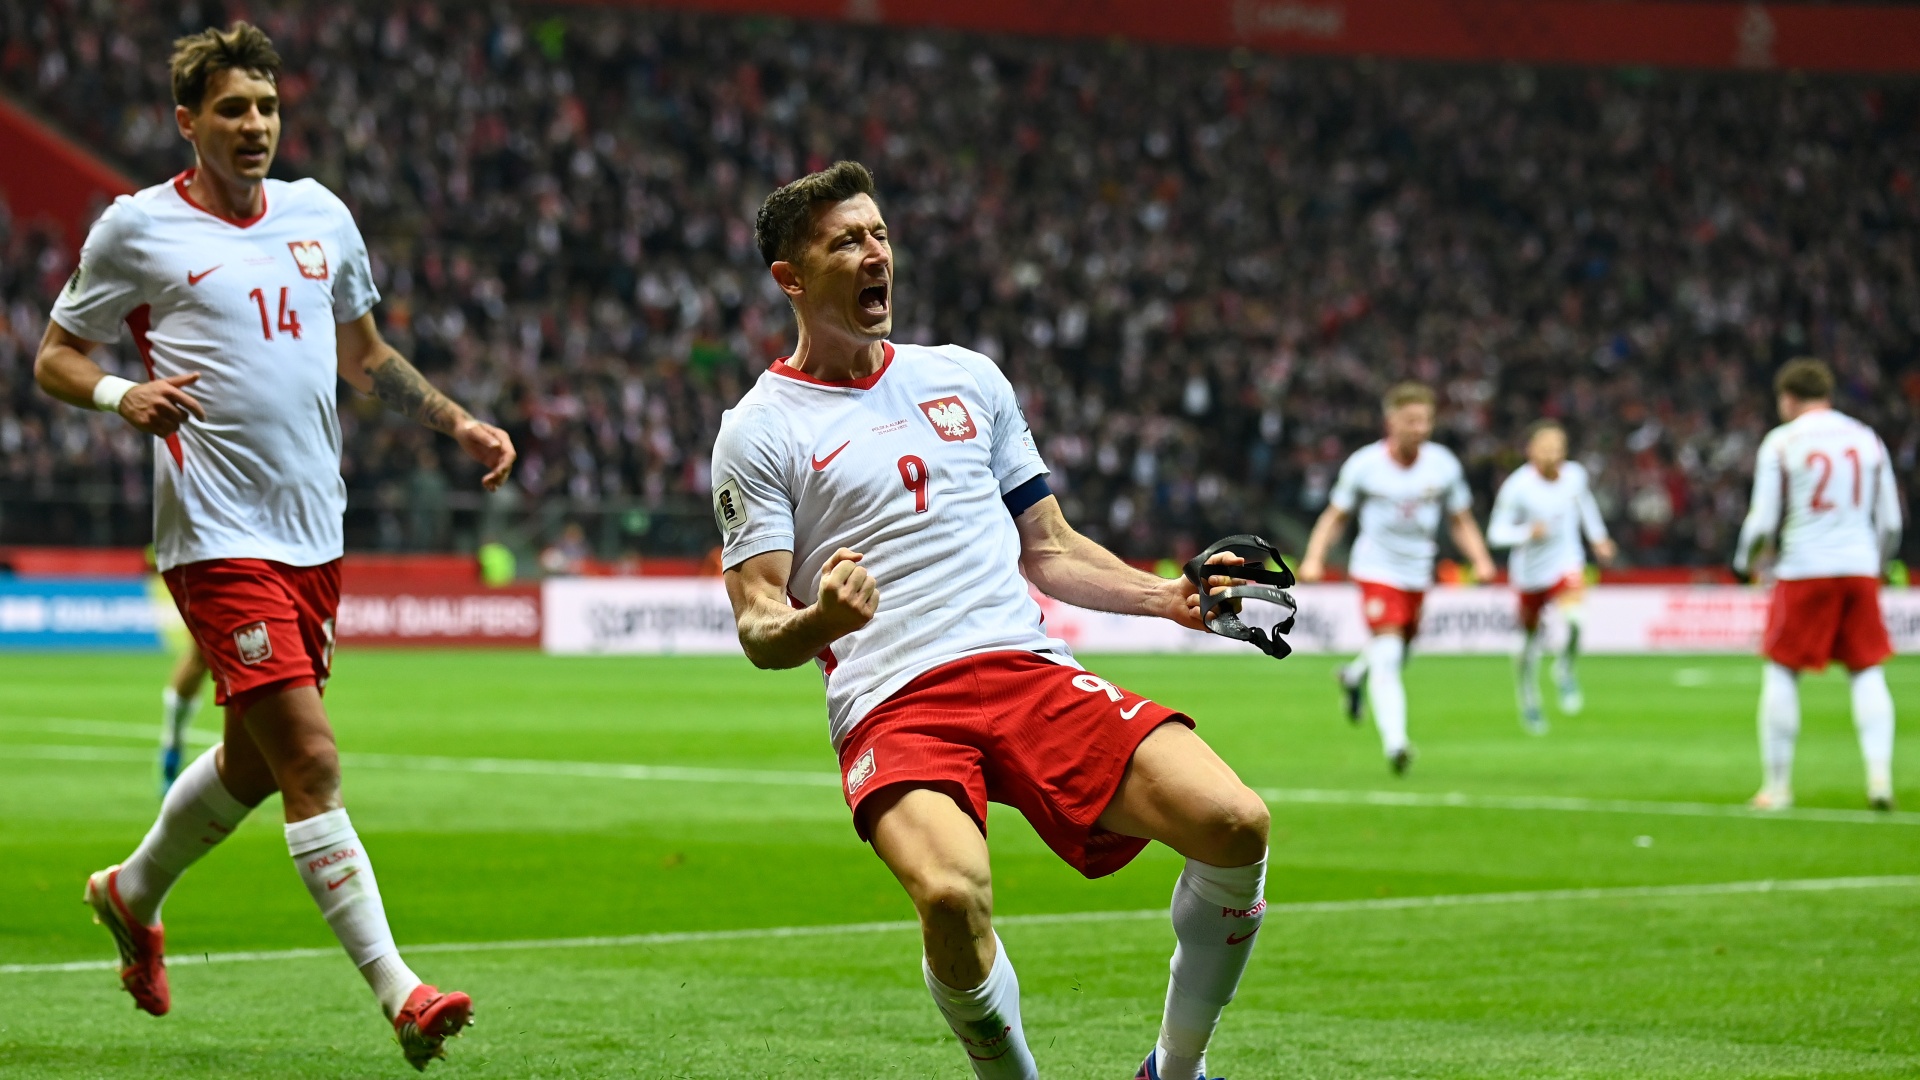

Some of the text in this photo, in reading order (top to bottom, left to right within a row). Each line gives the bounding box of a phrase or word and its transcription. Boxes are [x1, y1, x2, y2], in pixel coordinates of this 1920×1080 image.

[249, 286, 303, 341] 14
[897, 454, 929, 514] 9
[1805, 447, 1862, 513] 21
[1071, 674, 1125, 703] 9
